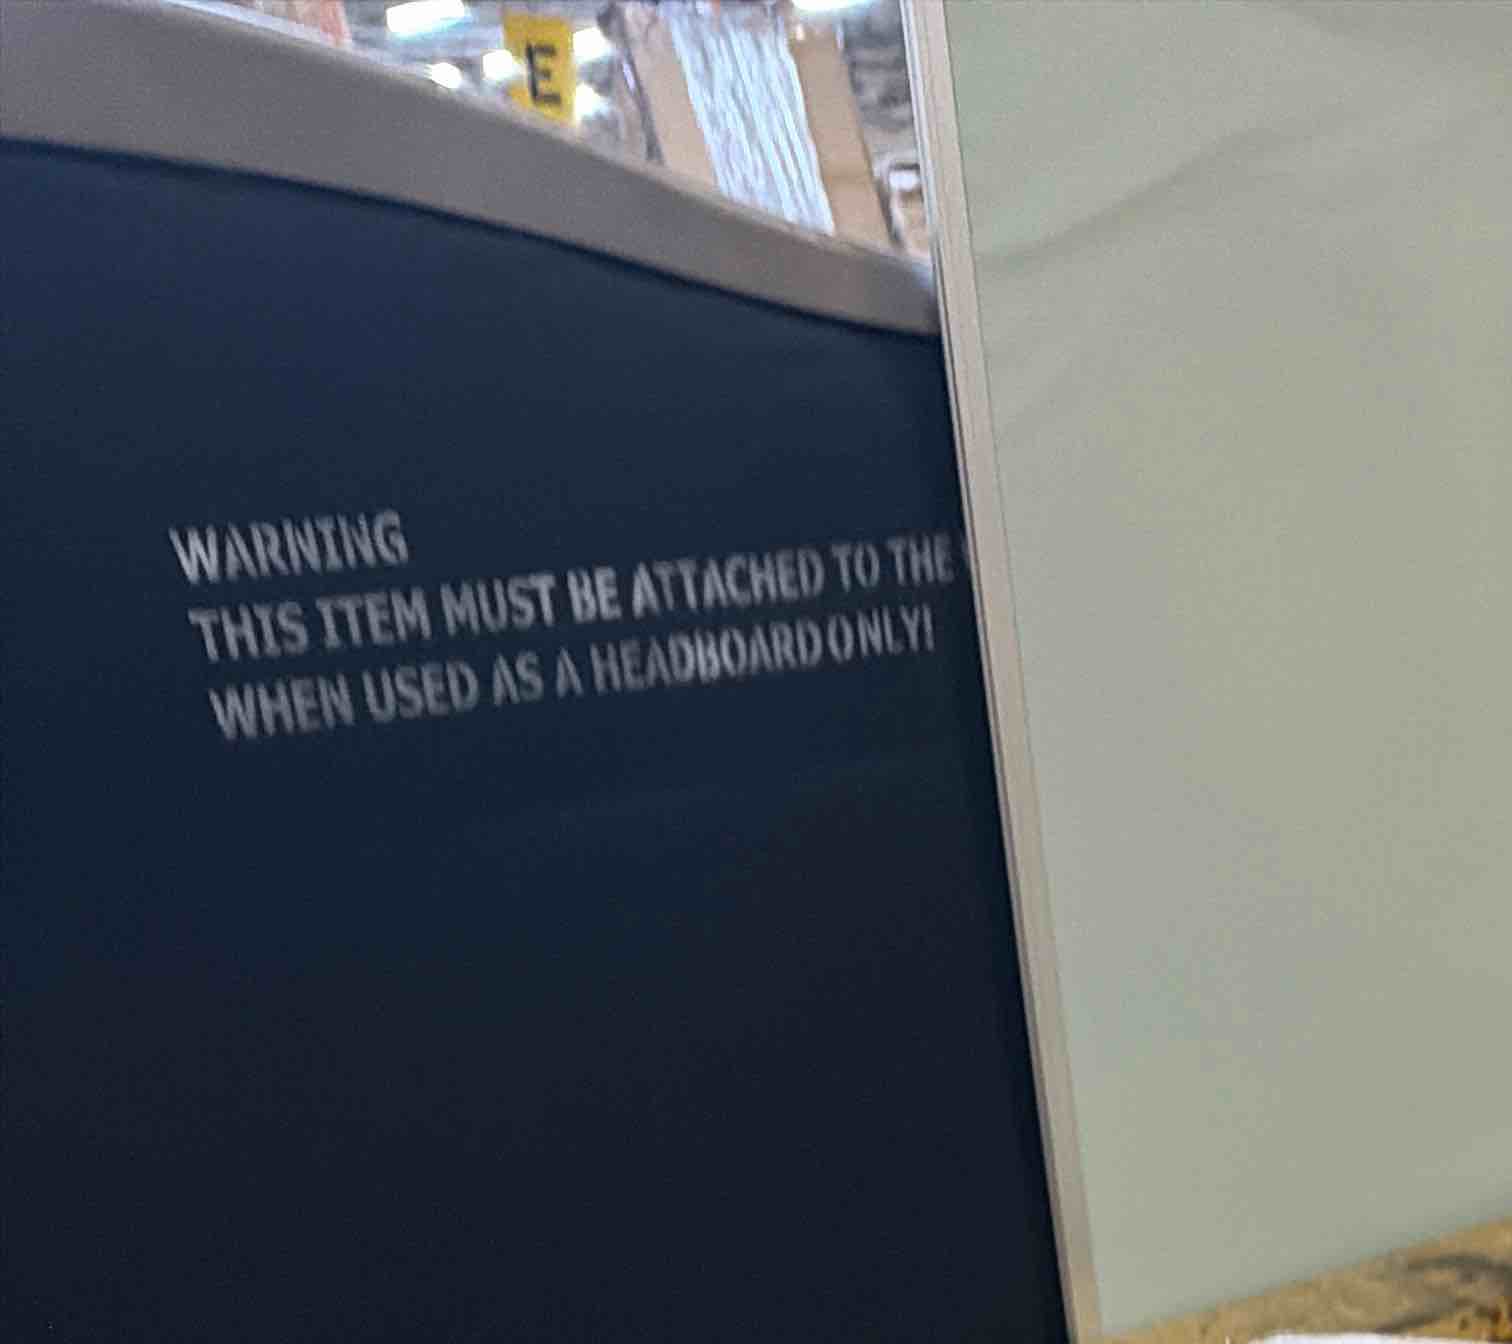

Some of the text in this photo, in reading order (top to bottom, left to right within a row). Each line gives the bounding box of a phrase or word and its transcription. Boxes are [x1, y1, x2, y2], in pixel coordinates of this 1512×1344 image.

[168, 508, 410, 586] WARNING
[187, 531, 956, 664] THIS ITEM MUST BE ATTACHED TO THE
[207, 602, 936, 741] WHEN USED AS A HEADBOARD ONLY!
